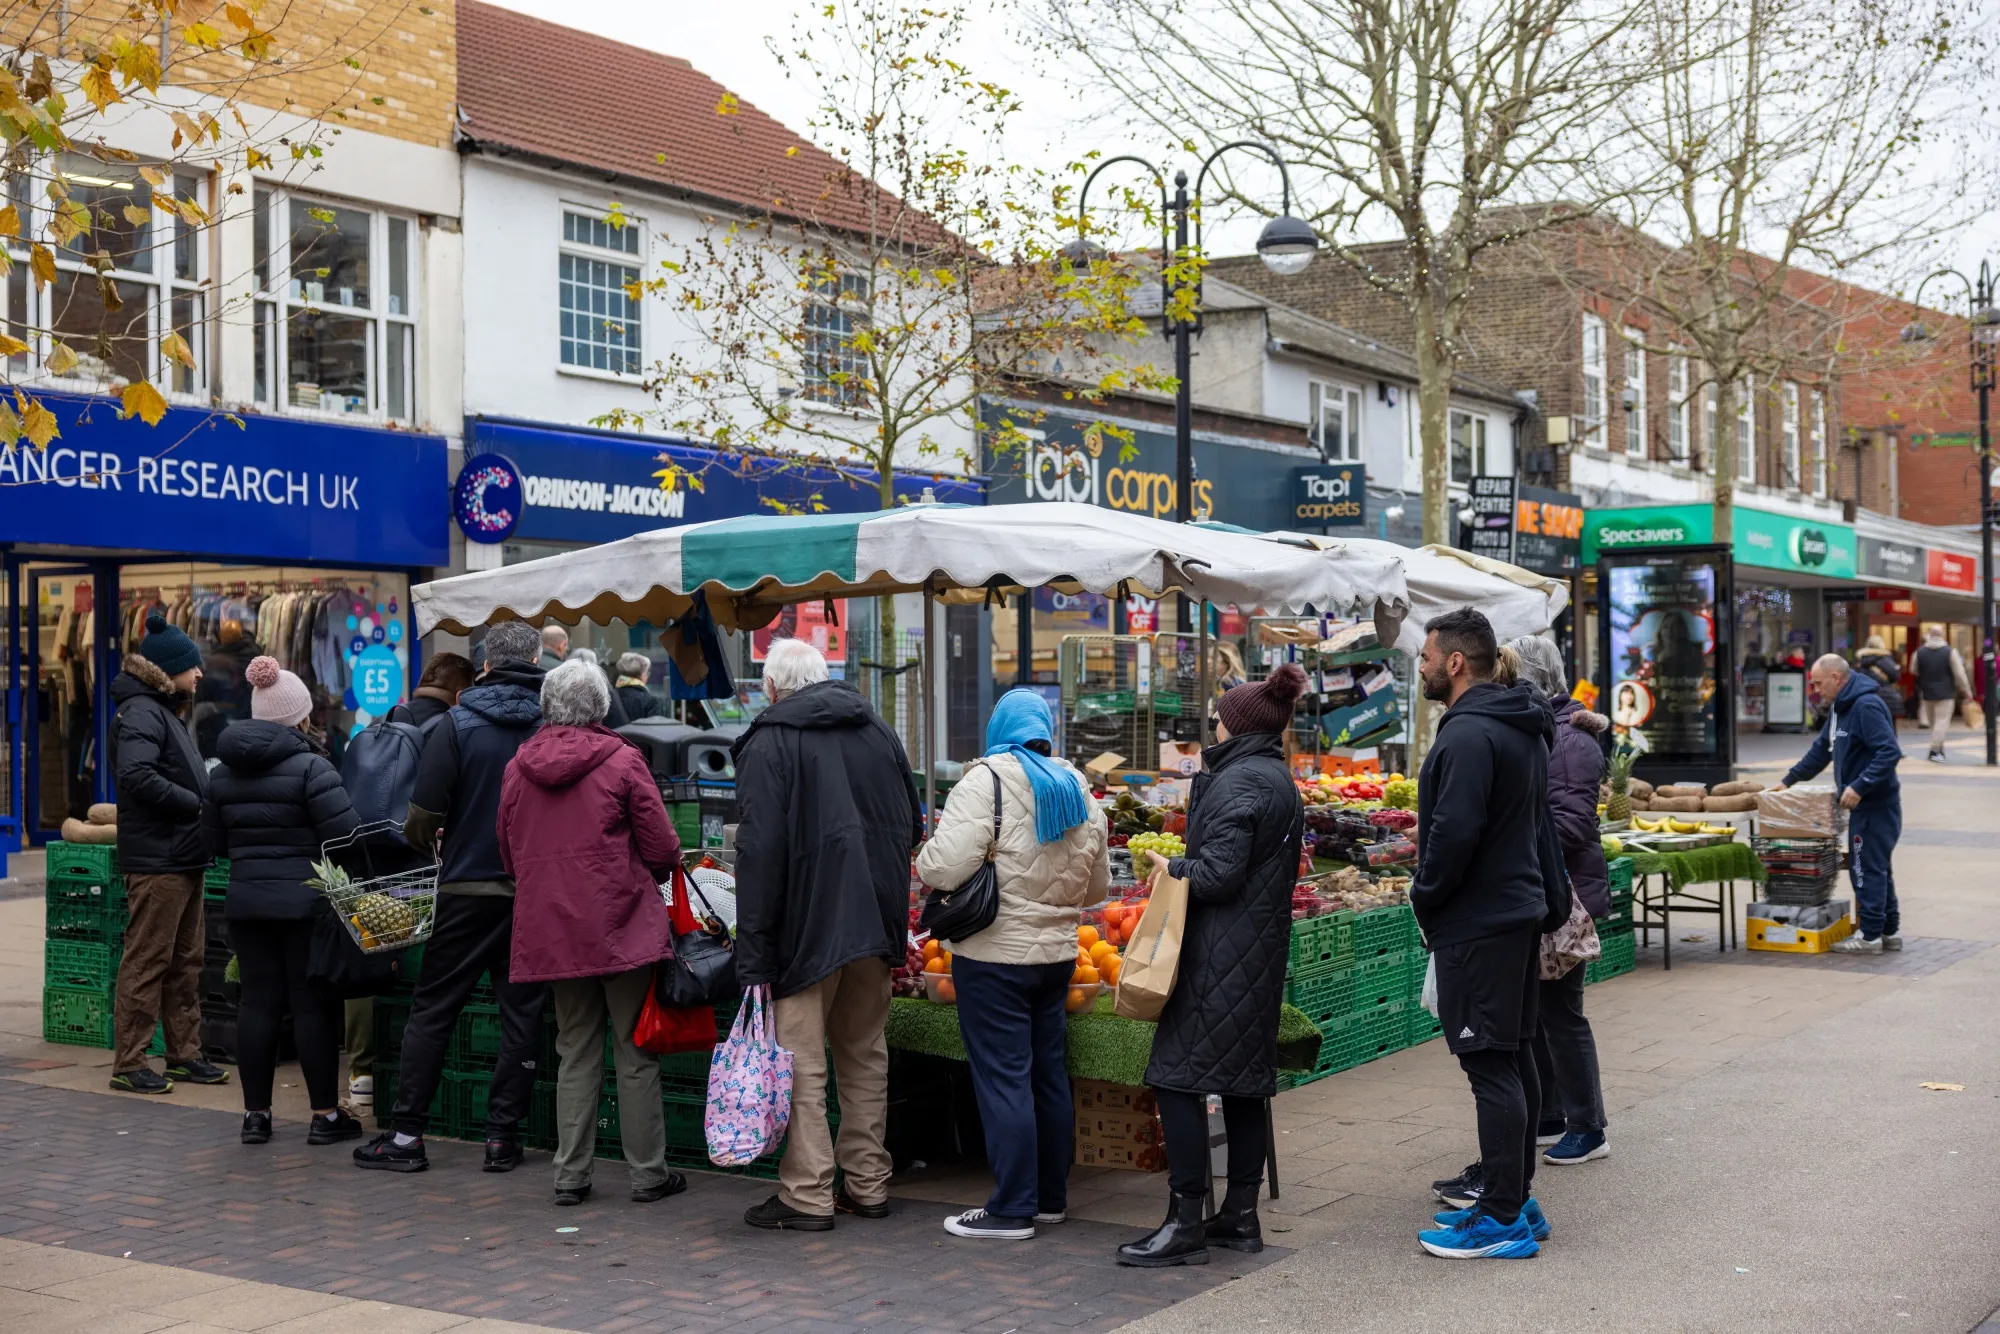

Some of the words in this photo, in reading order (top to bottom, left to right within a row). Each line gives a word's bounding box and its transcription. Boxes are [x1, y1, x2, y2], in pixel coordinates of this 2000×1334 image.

[138, 456, 309, 506] RESEARCH
[320, 473, 360, 511] UK
[1301, 470, 1352, 502] Tapi
[1475, 479, 1511, 495] REPAIR
[522, 476, 685, 518] OBINSON-JACKSON
[1474, 497, 1512, 513] CENTRE
[1296, 500, 1361, 520] carpets
[1542, 503, 1584, 539] SHOP
[1599, 527, 1684, 547] Specsavers
[1131, 613, 1152, 629] OFF
[364, 668, 390, 694] £5
